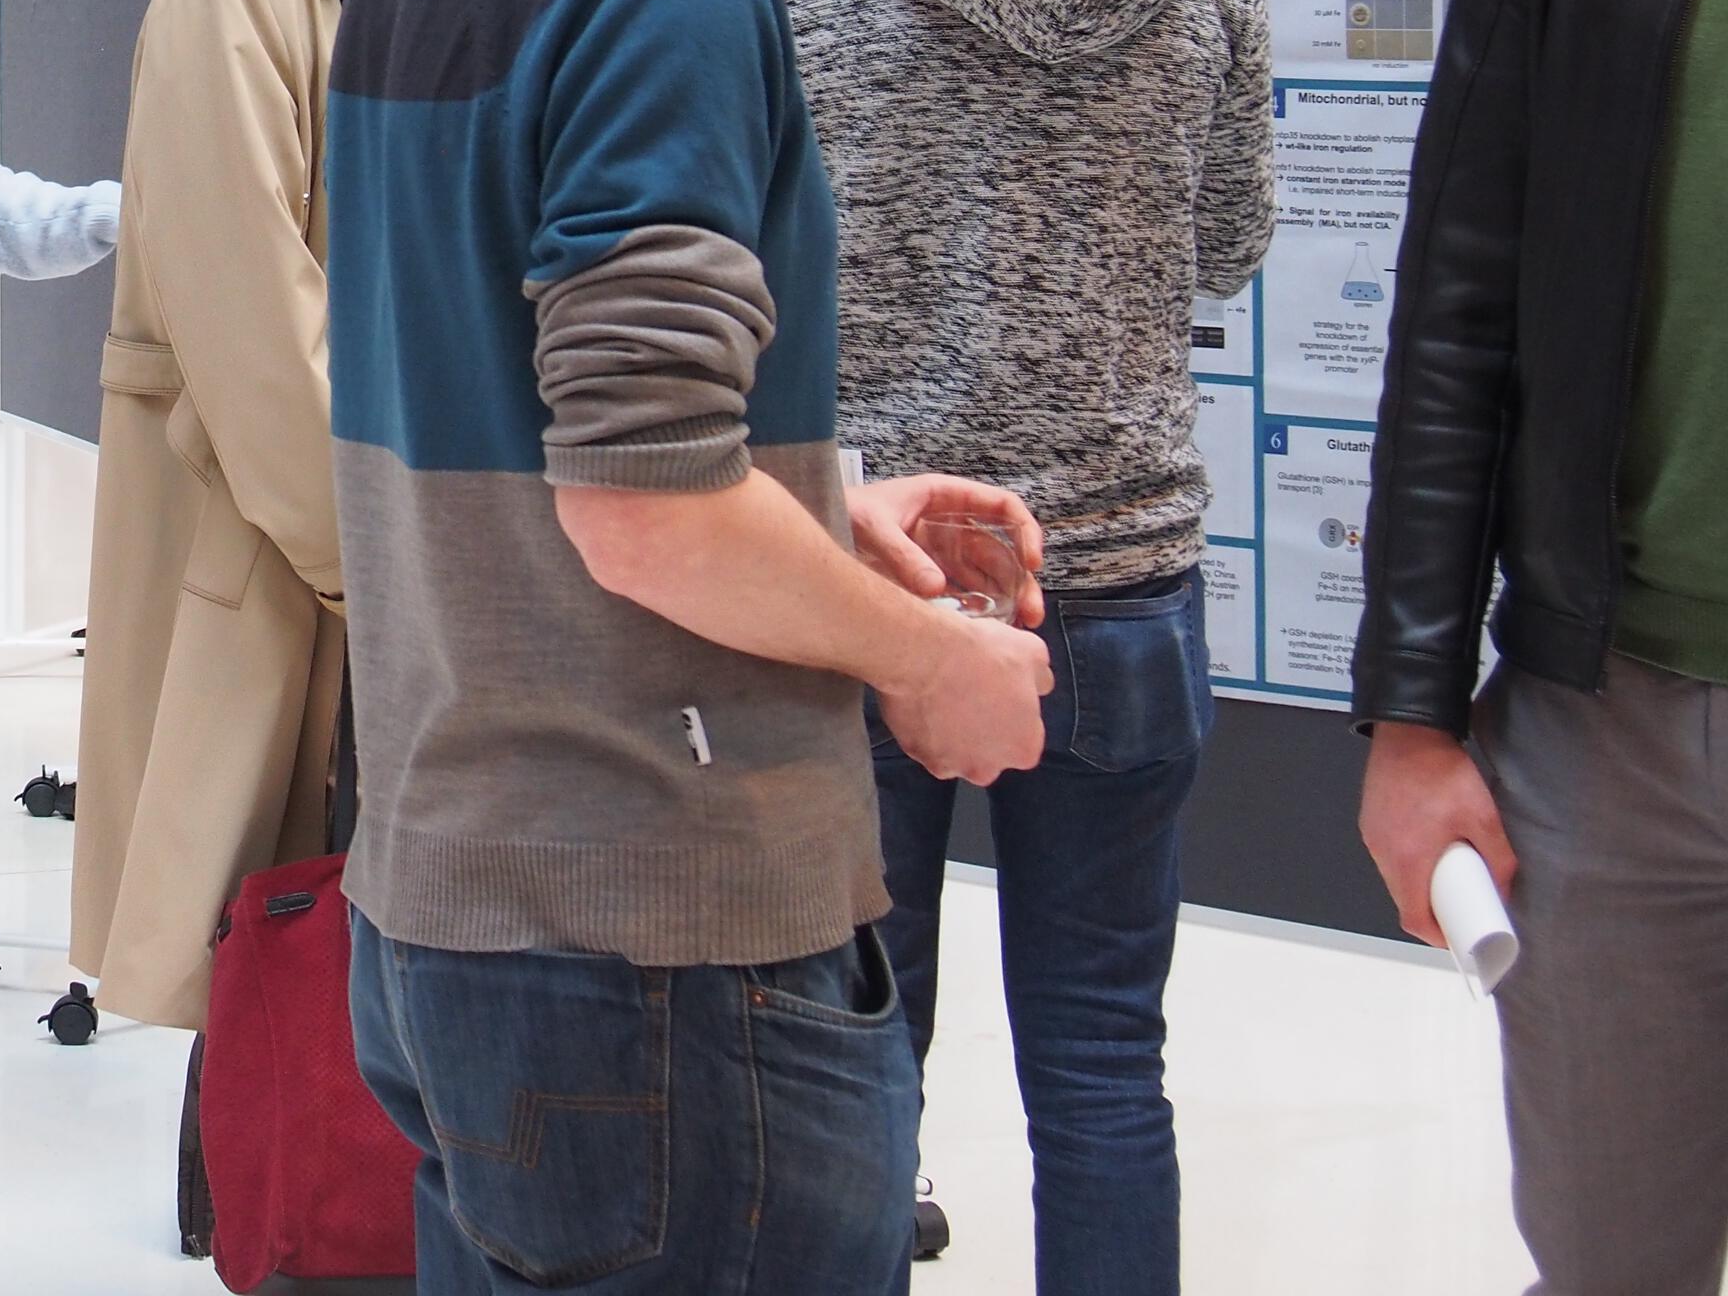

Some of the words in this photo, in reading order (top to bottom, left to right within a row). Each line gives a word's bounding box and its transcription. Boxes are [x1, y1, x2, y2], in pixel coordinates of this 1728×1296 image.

[1298, 92, 1384, 106] Mitochondrial,
[1387, 94, 1408, 105] but
[1270, 432, 1282, 449] 6
[1326, 439, 1371, 453] Glutath
